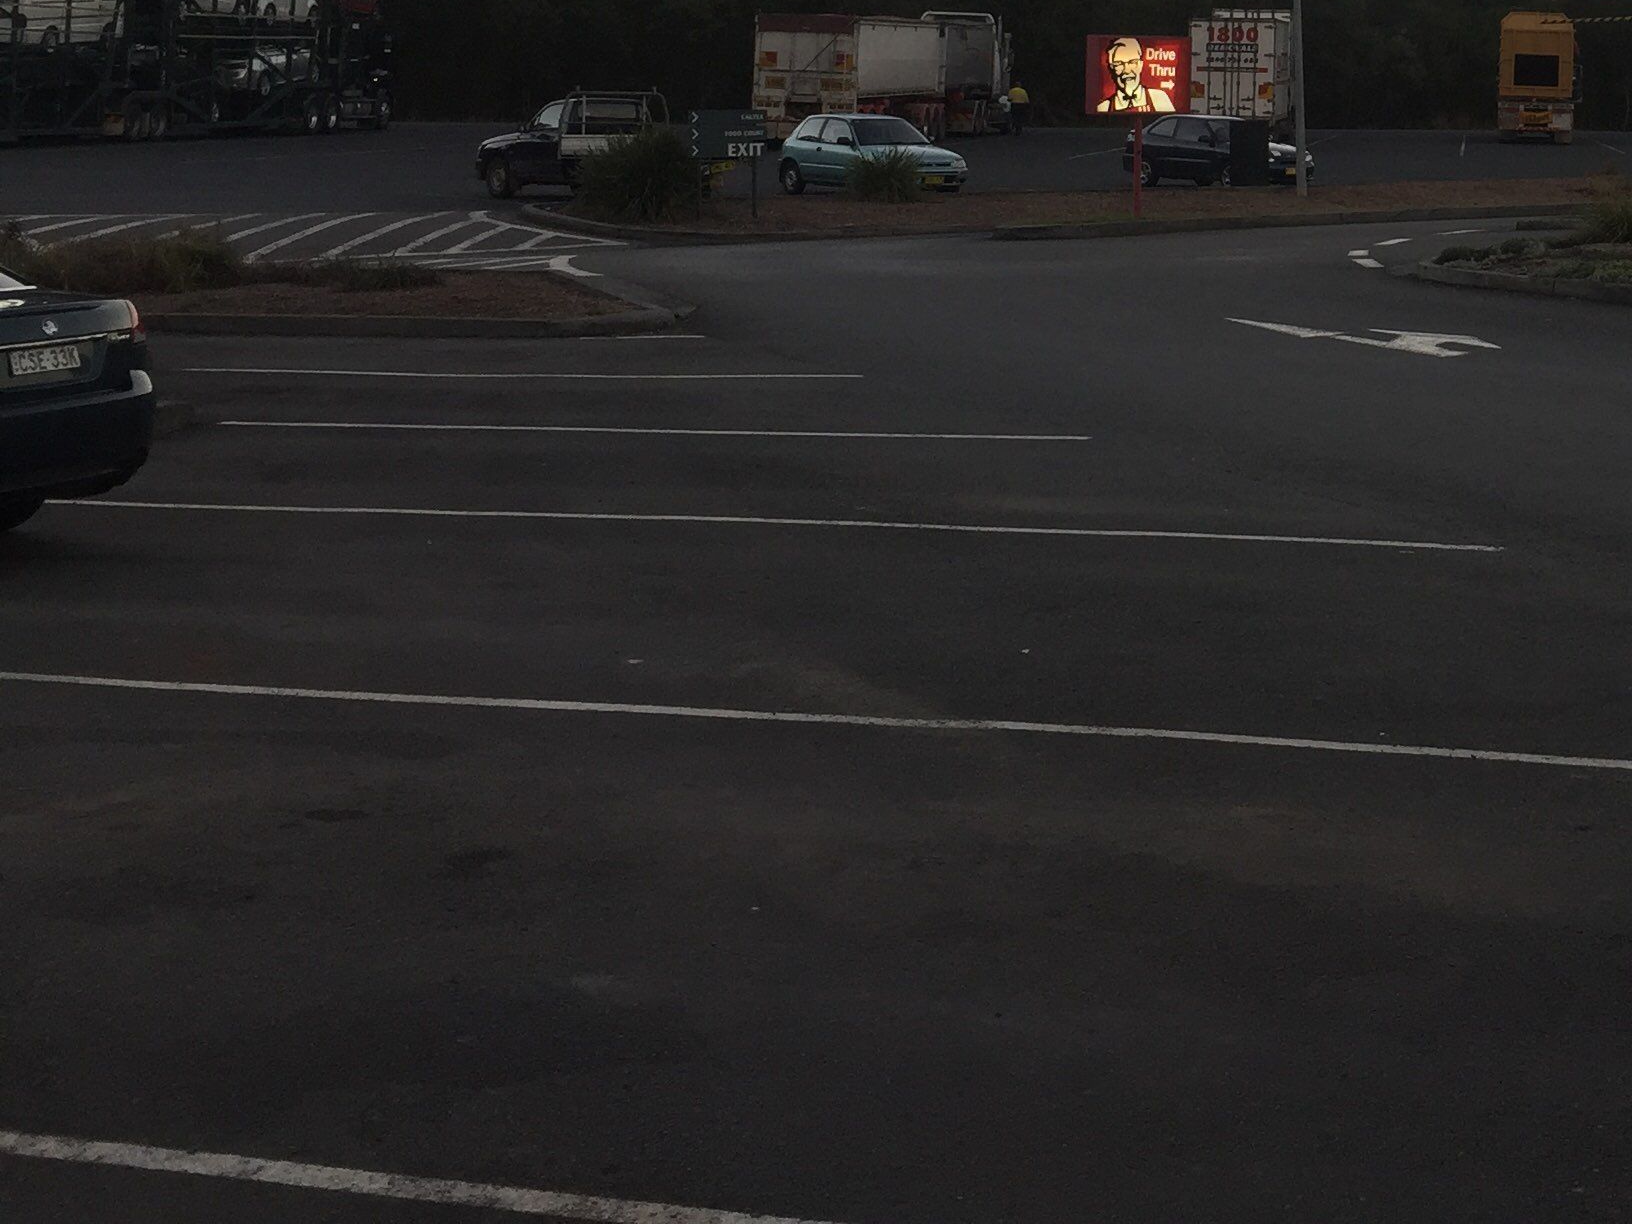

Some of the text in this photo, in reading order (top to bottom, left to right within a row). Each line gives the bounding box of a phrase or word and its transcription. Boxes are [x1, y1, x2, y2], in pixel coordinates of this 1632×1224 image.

[1207, 26, 1258, 42] 1800
[1145, 47, 1176, 61] Drive
[1149, 63, 1176, 77] Thru
[727, 143, 765, 157] EXIT
